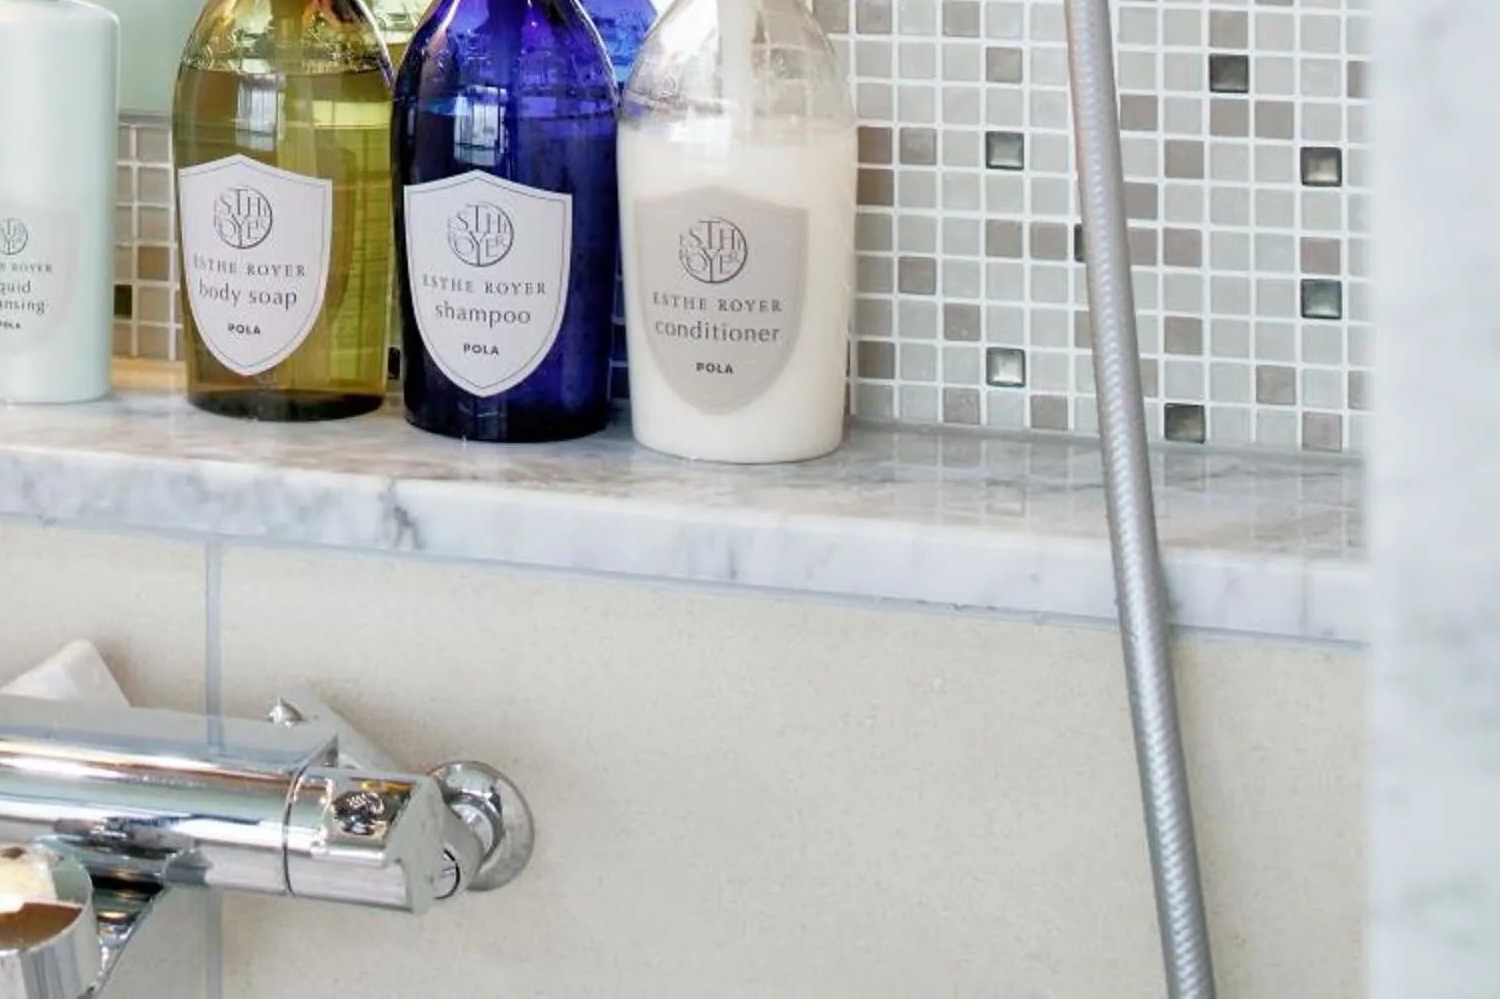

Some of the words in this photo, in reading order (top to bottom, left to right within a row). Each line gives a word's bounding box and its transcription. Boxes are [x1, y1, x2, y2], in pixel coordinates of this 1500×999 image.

[193, 252, 237, 274] ESTHE
[246, 264, 306, 278] ROYER
[199, 278, 241, 307] body
[249, 289, 298, 310] soap
[422, 273, 476, 293] ESTHE
[485, 281, 547, 295] ROYER
[652, 291, 707, 311] ESTHE
[718, 298, 783, 313] ROYER
[435, 300, 531, 329] shampoo
[227, 322, 262, 335] POLA
[654, 320, 781, 343] conditioner
[463, 343, 499, 355] POLA
[695, 361, 734, 374] POLA
